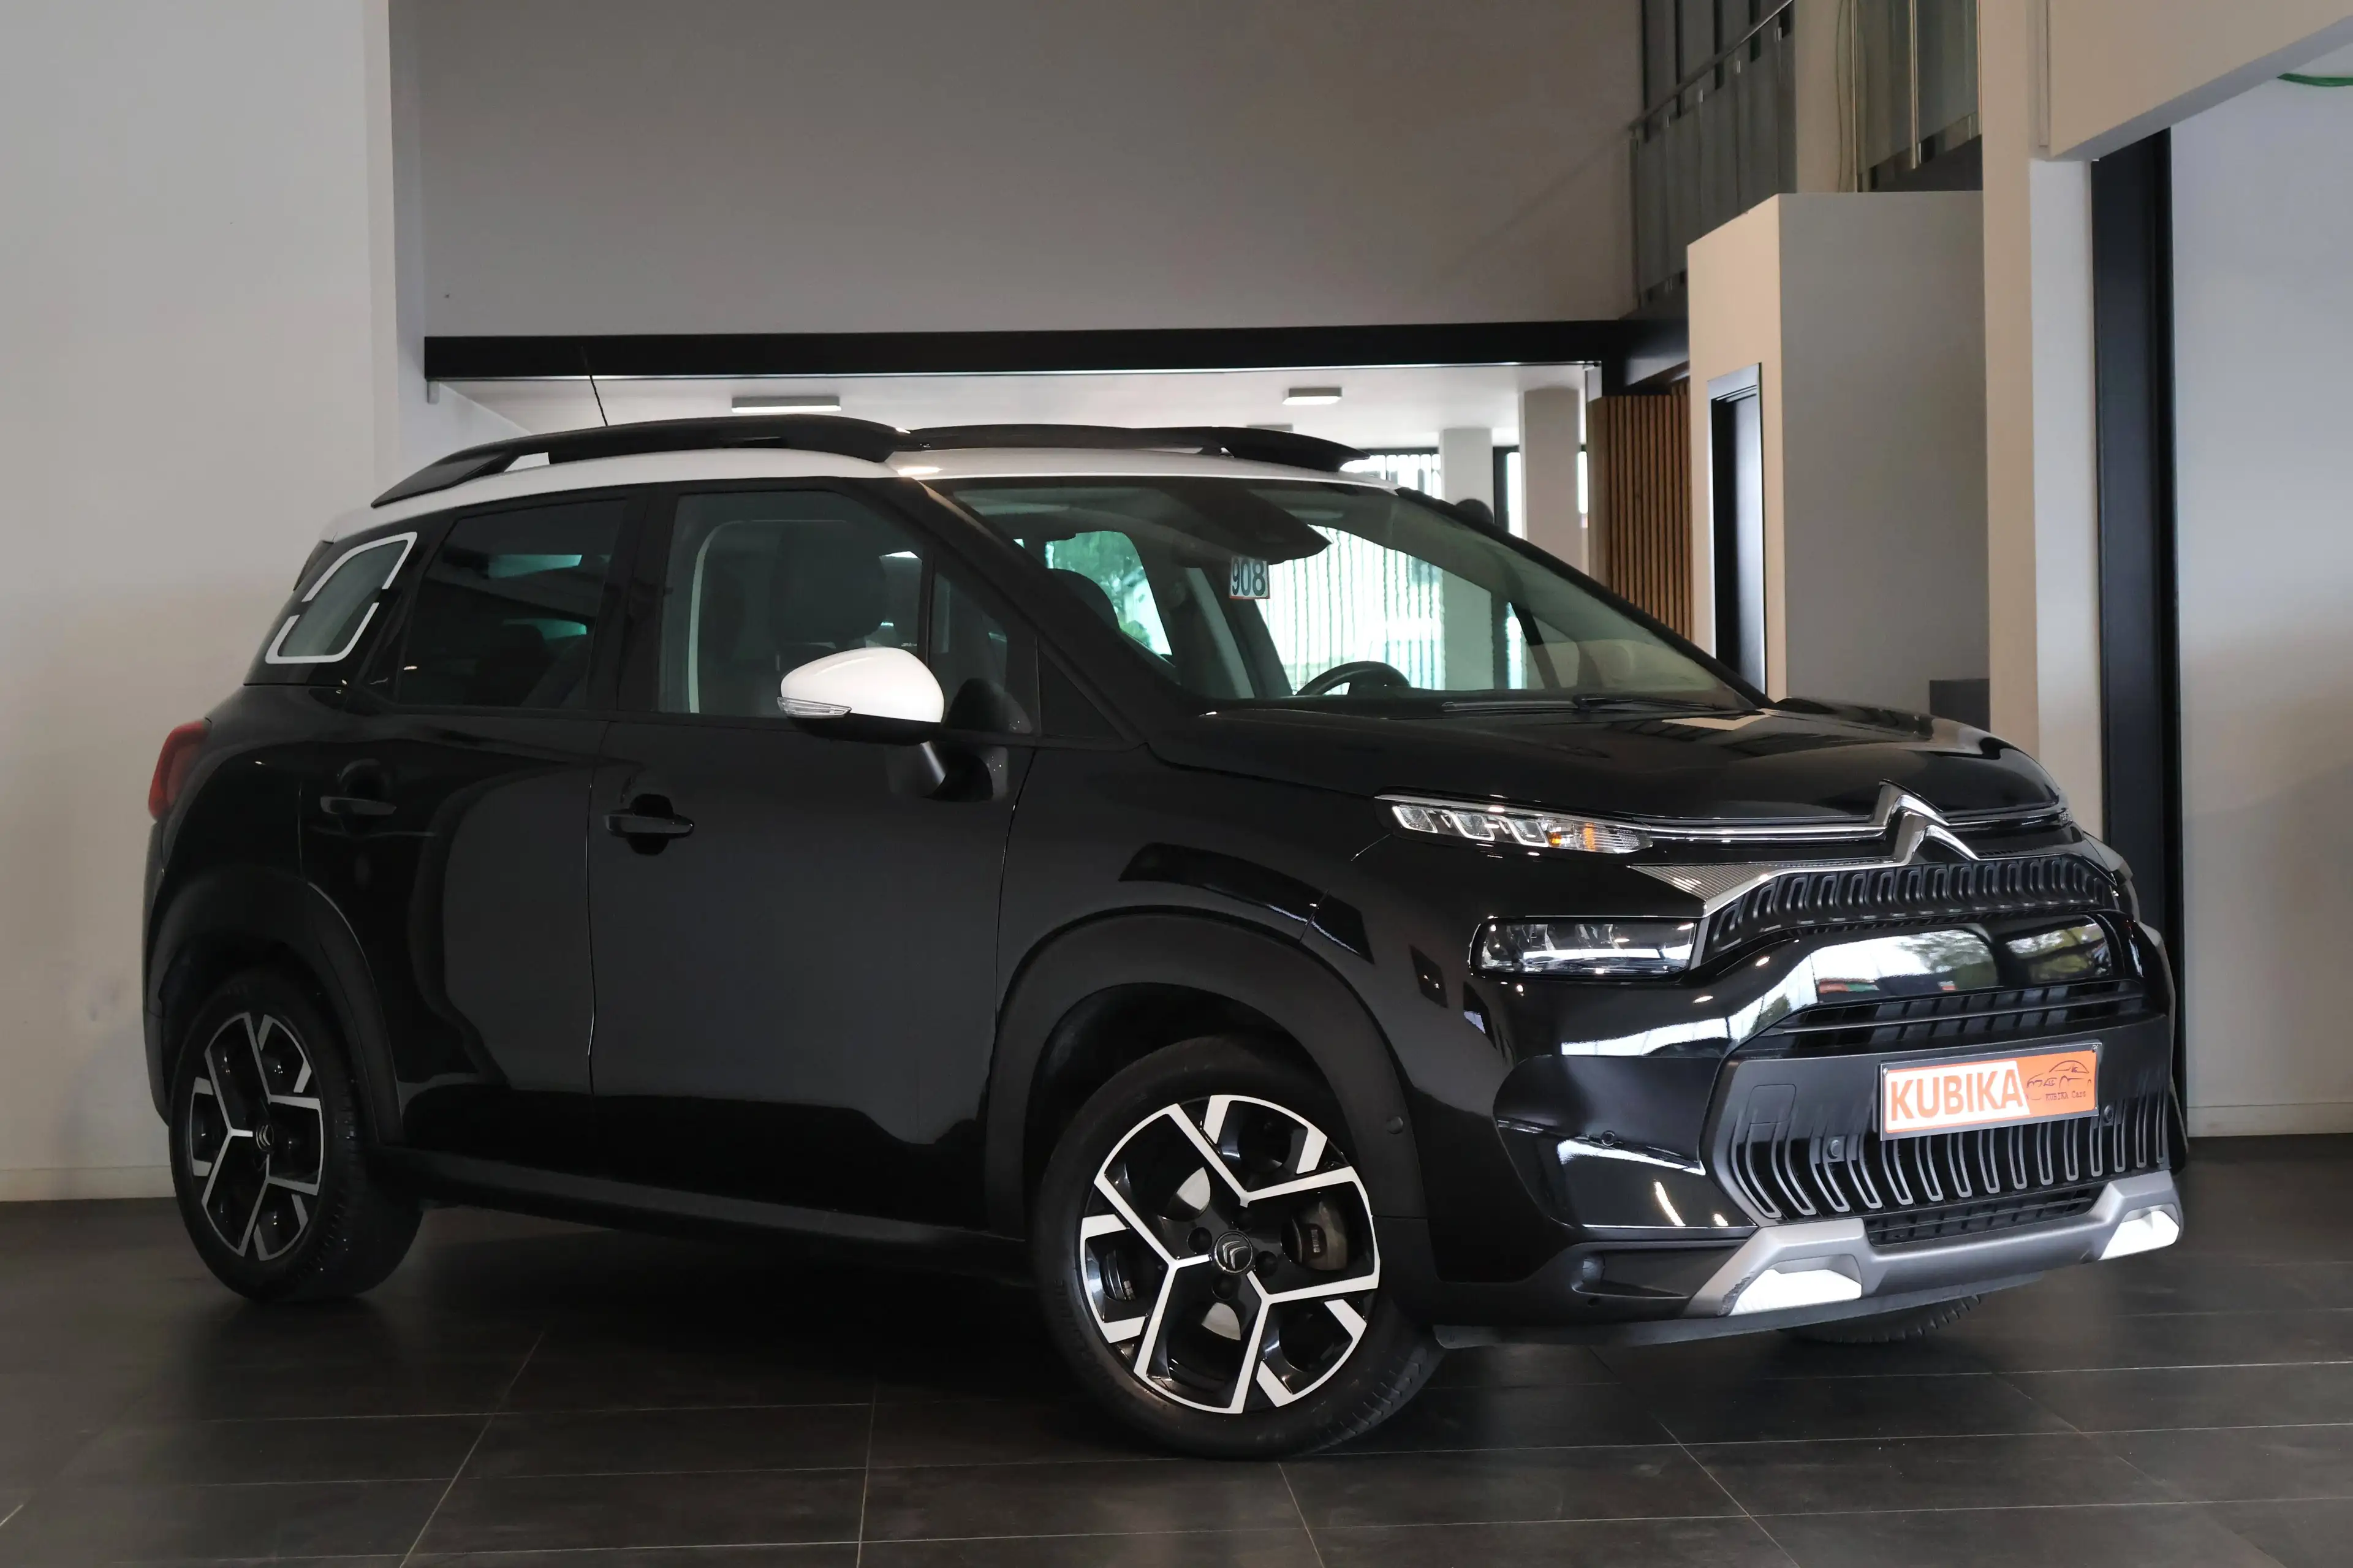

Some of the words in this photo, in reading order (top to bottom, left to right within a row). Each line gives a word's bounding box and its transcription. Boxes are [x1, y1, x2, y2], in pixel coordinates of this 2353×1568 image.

[1232, 558, 1266, 596] 908
[1891, 1069, 2023, 1121] KUBIKA
[2045, 1091, 2069, 1101] KUBIKA
[2071, 1090, 2086, 1099] Cars
